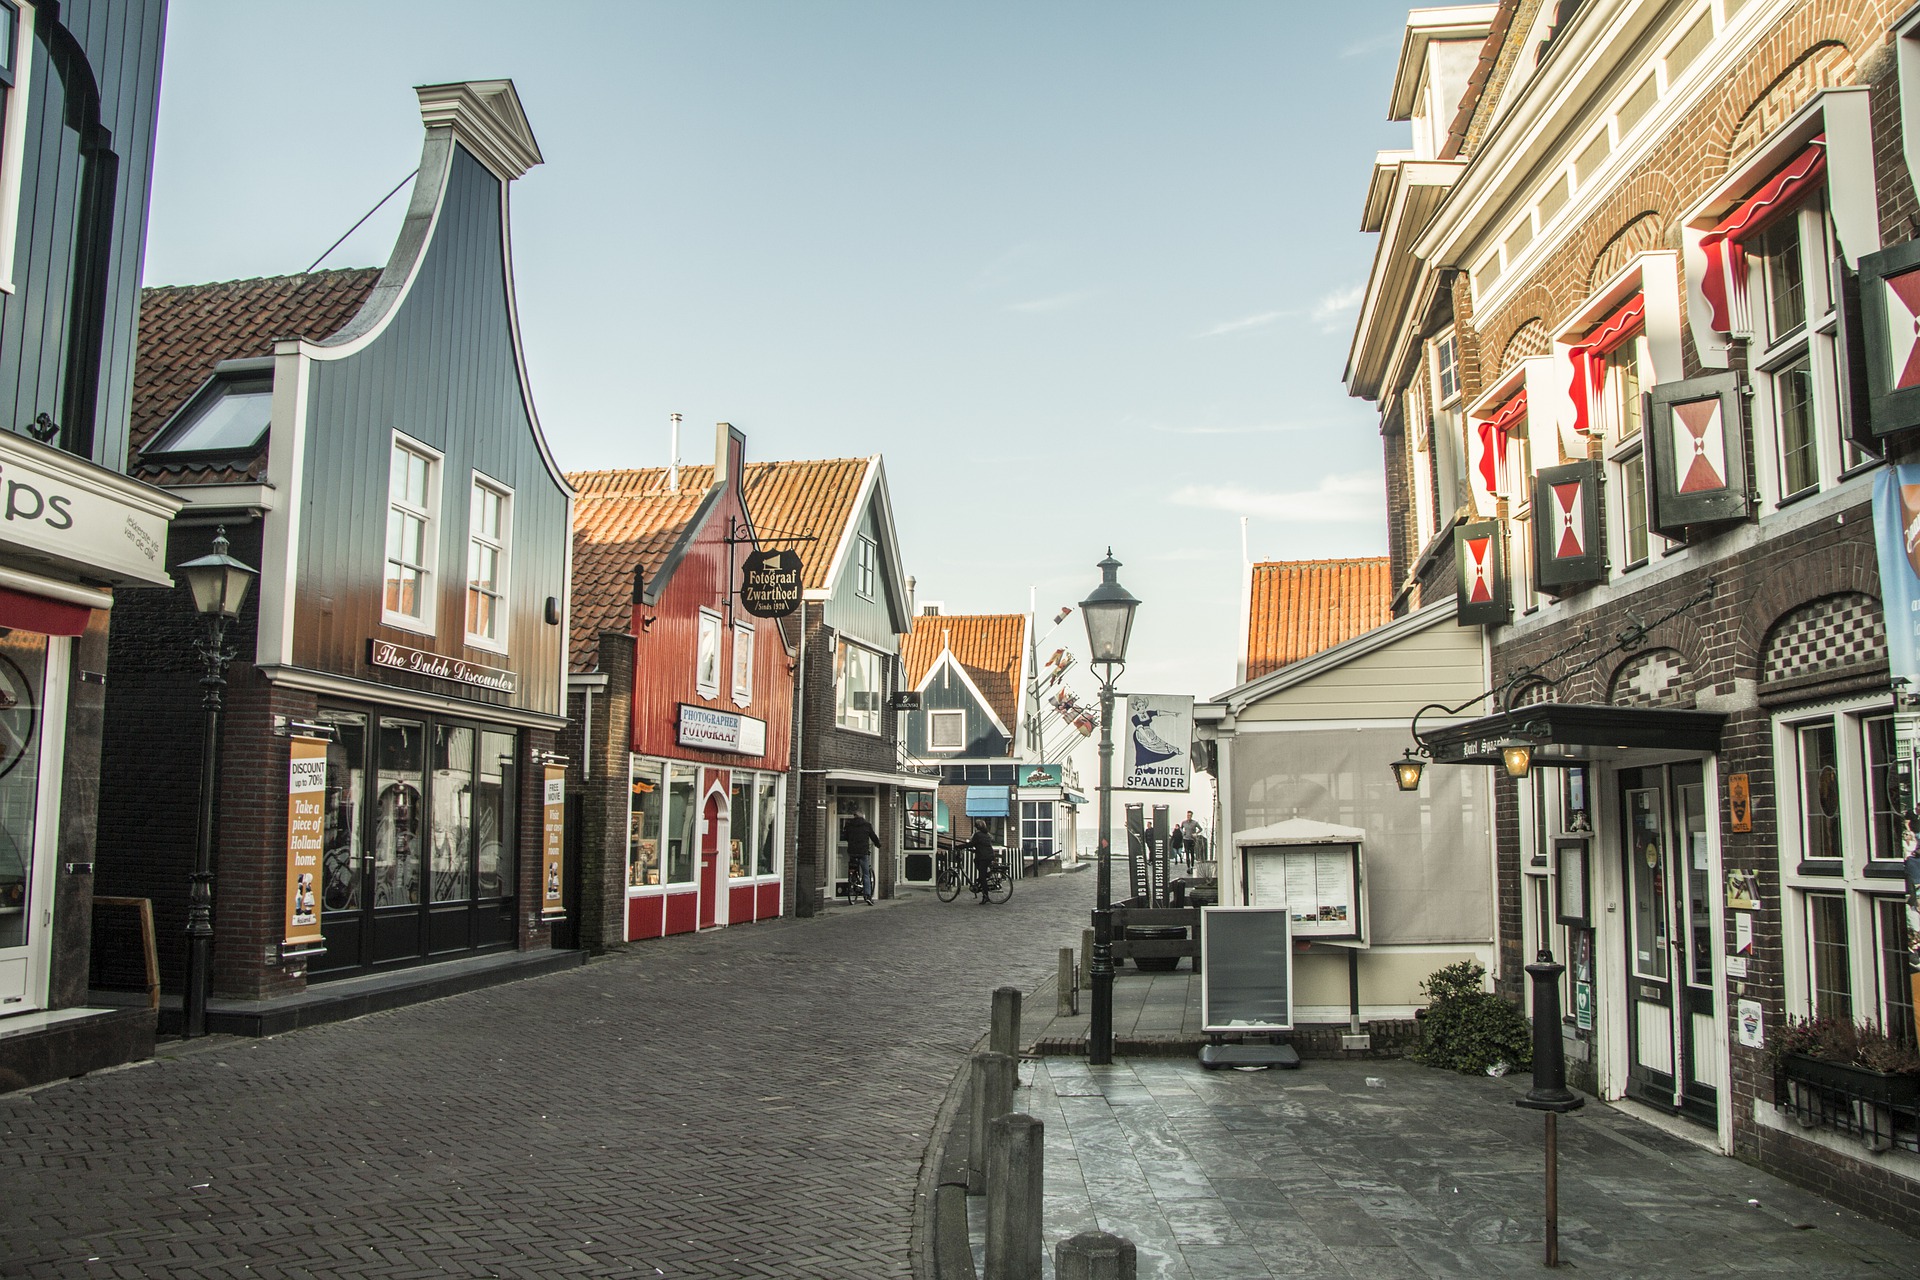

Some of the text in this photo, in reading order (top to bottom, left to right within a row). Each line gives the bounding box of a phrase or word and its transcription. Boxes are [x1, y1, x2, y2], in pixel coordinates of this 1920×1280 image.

[750, 569, 797, 587] Fotograaf
[746, 585, 798, 601] Zwarthoed
[377, 644, 515, 690] The Dutch Discounter
[683, 709, 738, 728] PHOTOGRAPHER
[292, 762, 325, 775] DISCOUNT
[1157, 766, 1185, 776] HOTEL
[294, 774, 323, 788] up to 70%
[549, 783, 559, 792] FREE
[1127, 776, 1184, 788] SPAANDER
[547, 792, 561, 801] MOVIE
[295, 799, 320, 815] Take a
[292, 816, 322, 834] piece of
[290, 835, 323, 850] Holland
[294, 851, 316, 866] home
[1135, 855, 1147, 897] COFFEE TO GO
[1155, 860, 1163, 887] ESPRESSO
[1155, 888, 1163, 900] BAR
